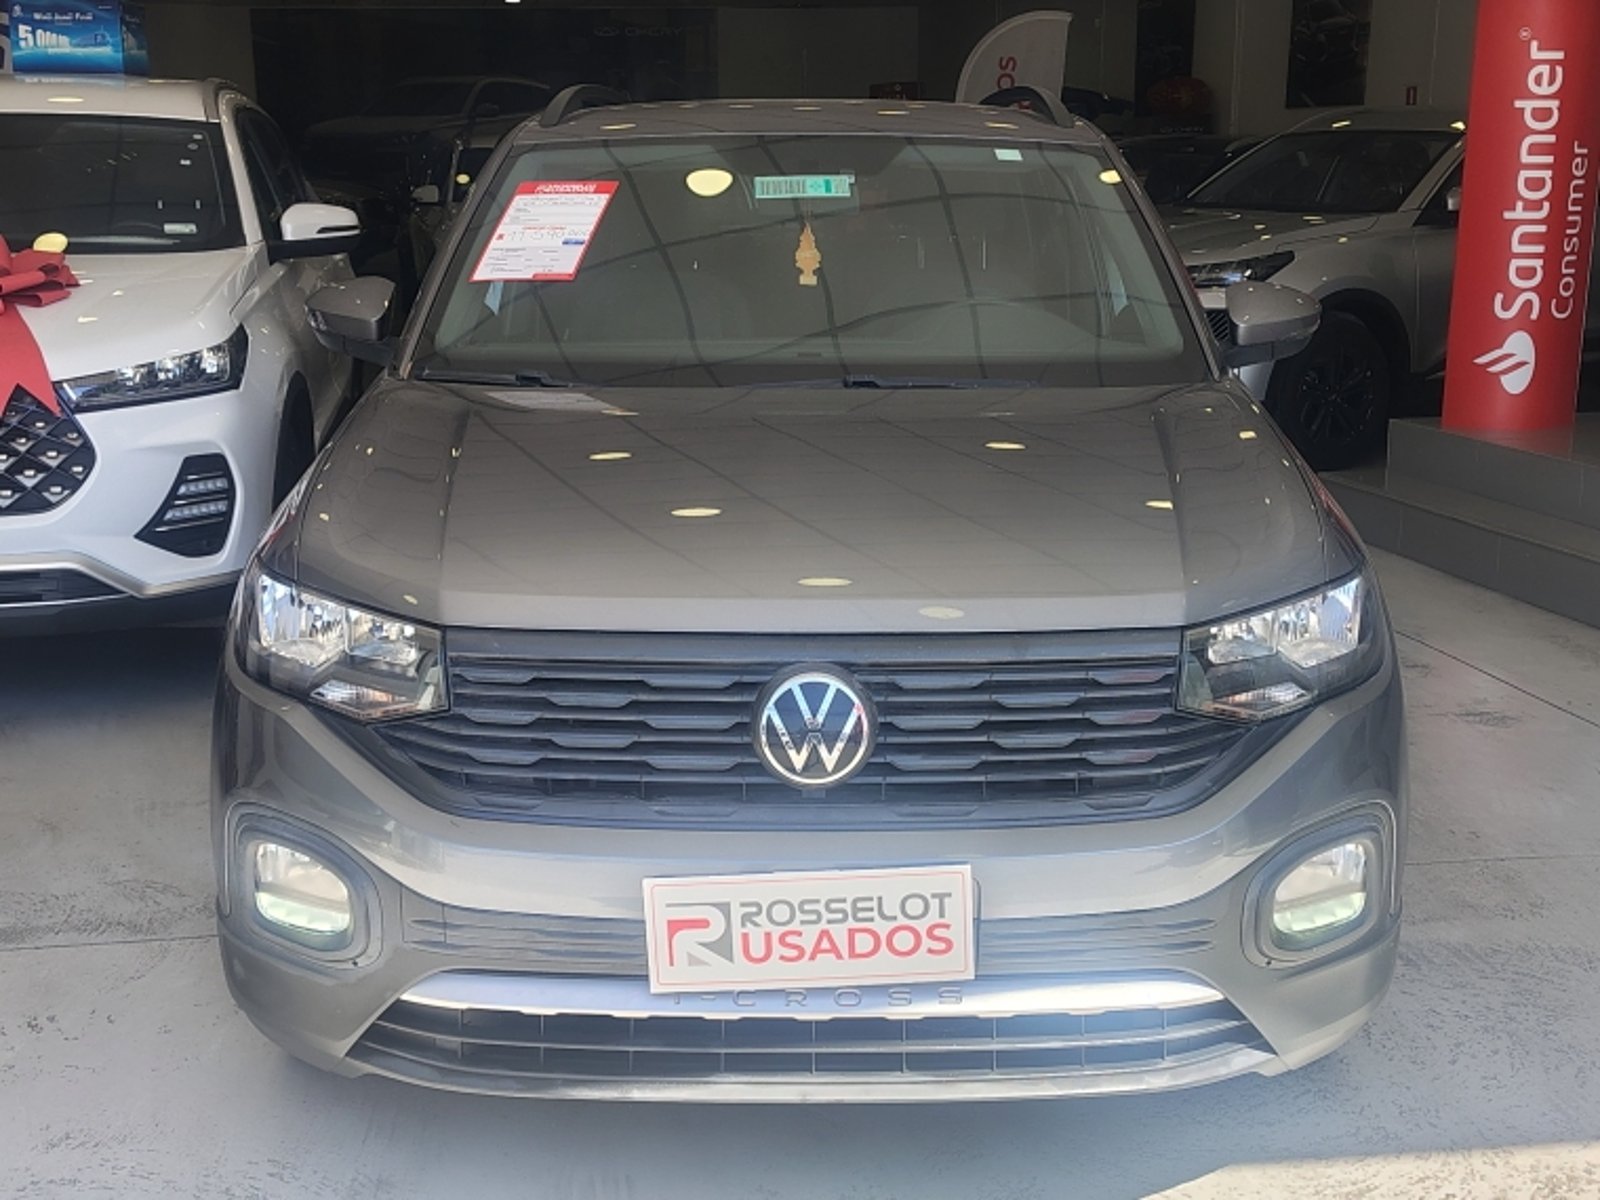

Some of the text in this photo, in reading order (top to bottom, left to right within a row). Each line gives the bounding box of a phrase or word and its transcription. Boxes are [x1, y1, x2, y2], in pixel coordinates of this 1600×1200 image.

[1494, 39, 1567, 320] Santander
[1551, 140, 1590, 320] Consumer
[739, 892, 952, 929] ROSSELOT
[740, 922, 954, 965] USADOS
